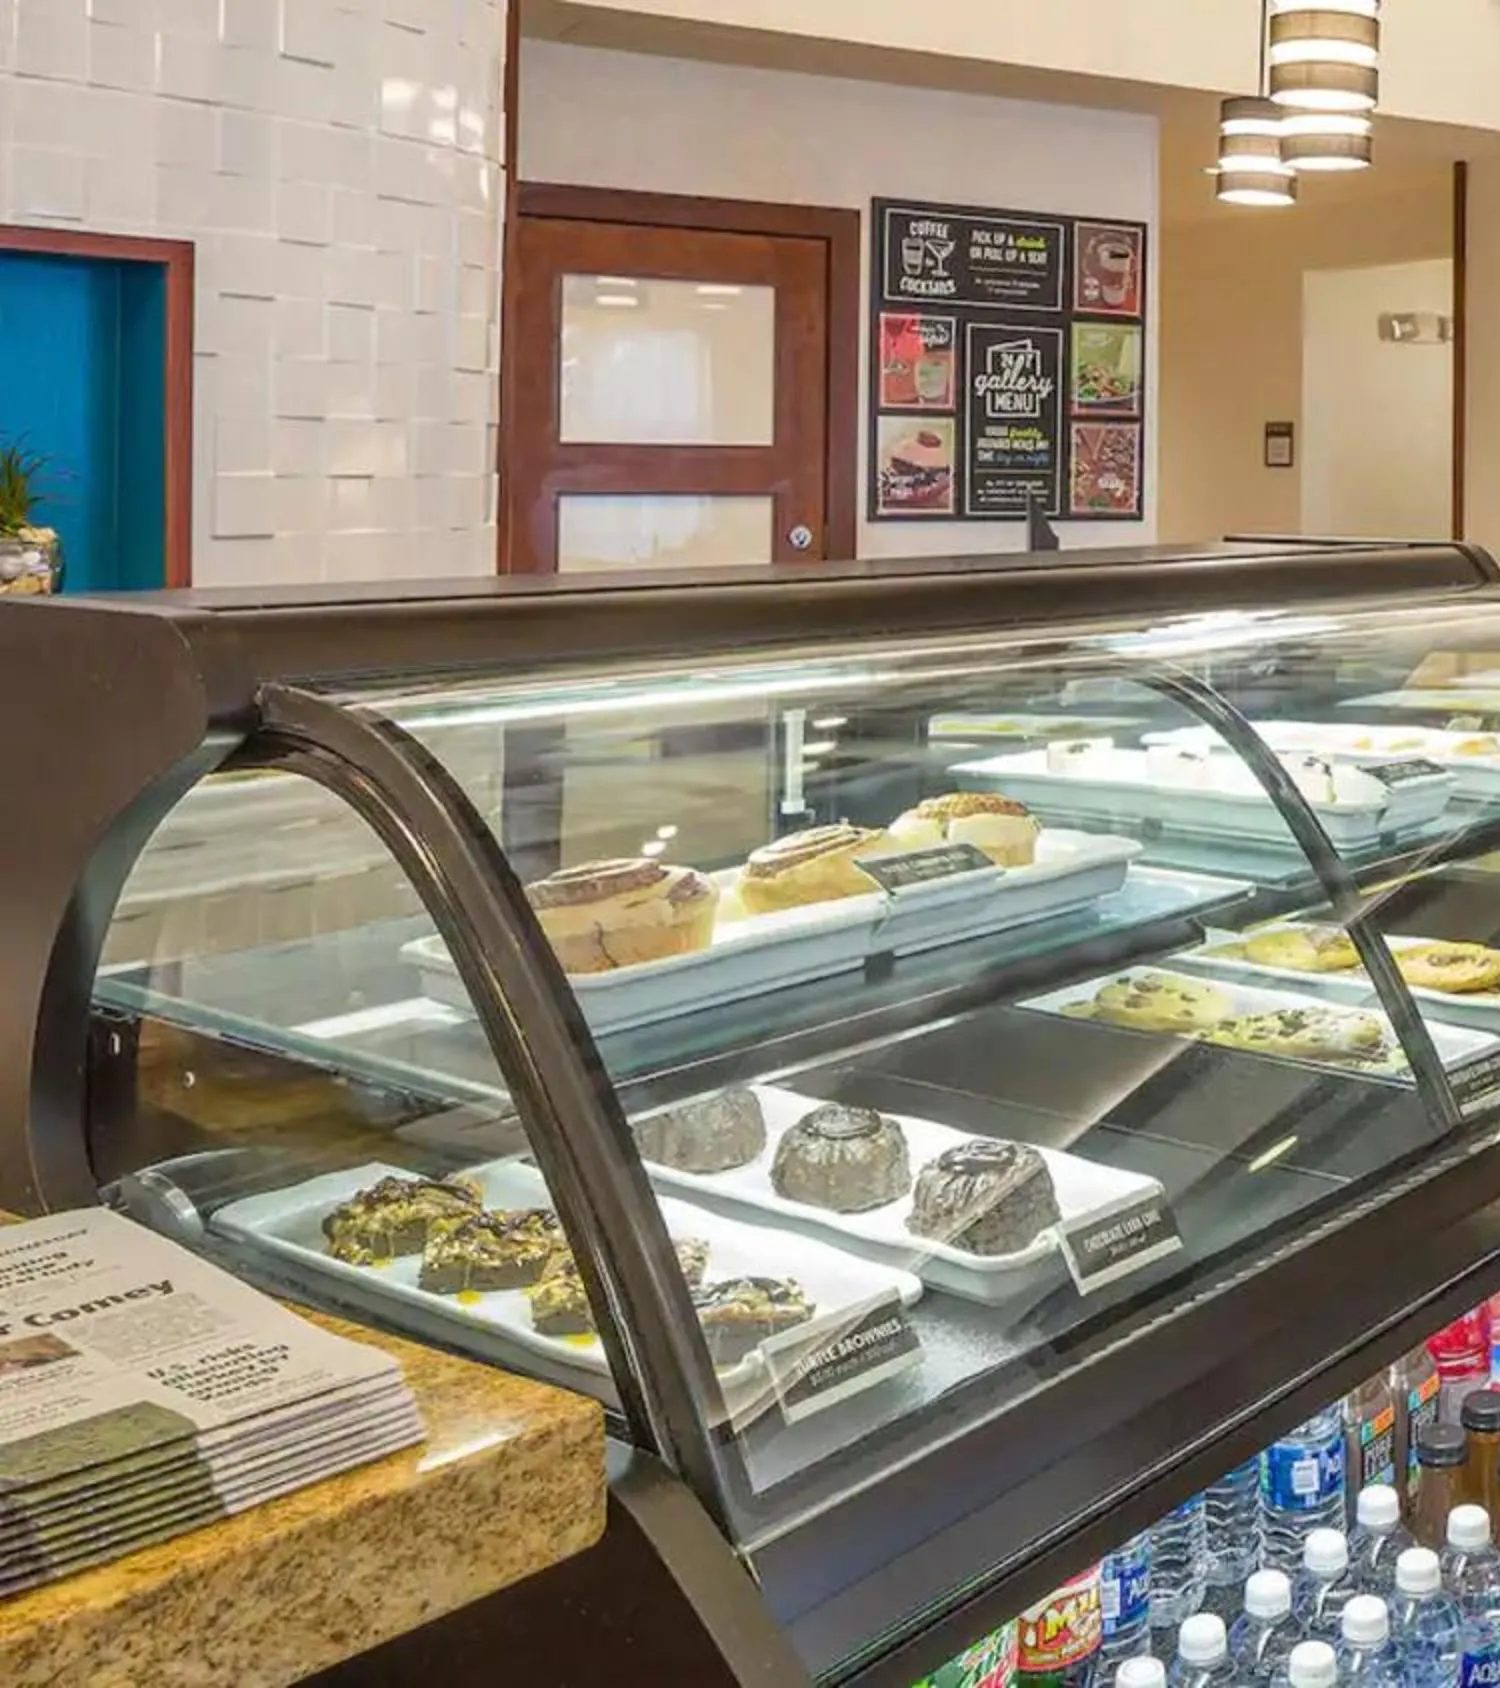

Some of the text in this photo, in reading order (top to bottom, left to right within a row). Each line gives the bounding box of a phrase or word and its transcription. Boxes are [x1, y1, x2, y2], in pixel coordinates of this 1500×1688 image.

[909, 221, 950, 239] COFFEE
[900, 276, 957, 296] COCKTAILS
[974, 354, 1054, 398] gallery
[994, 392, 1033, 411] MENU
[23, 1279, 175, 1328] Comey
[838, 1317, 901, 1357] BROWNIES
